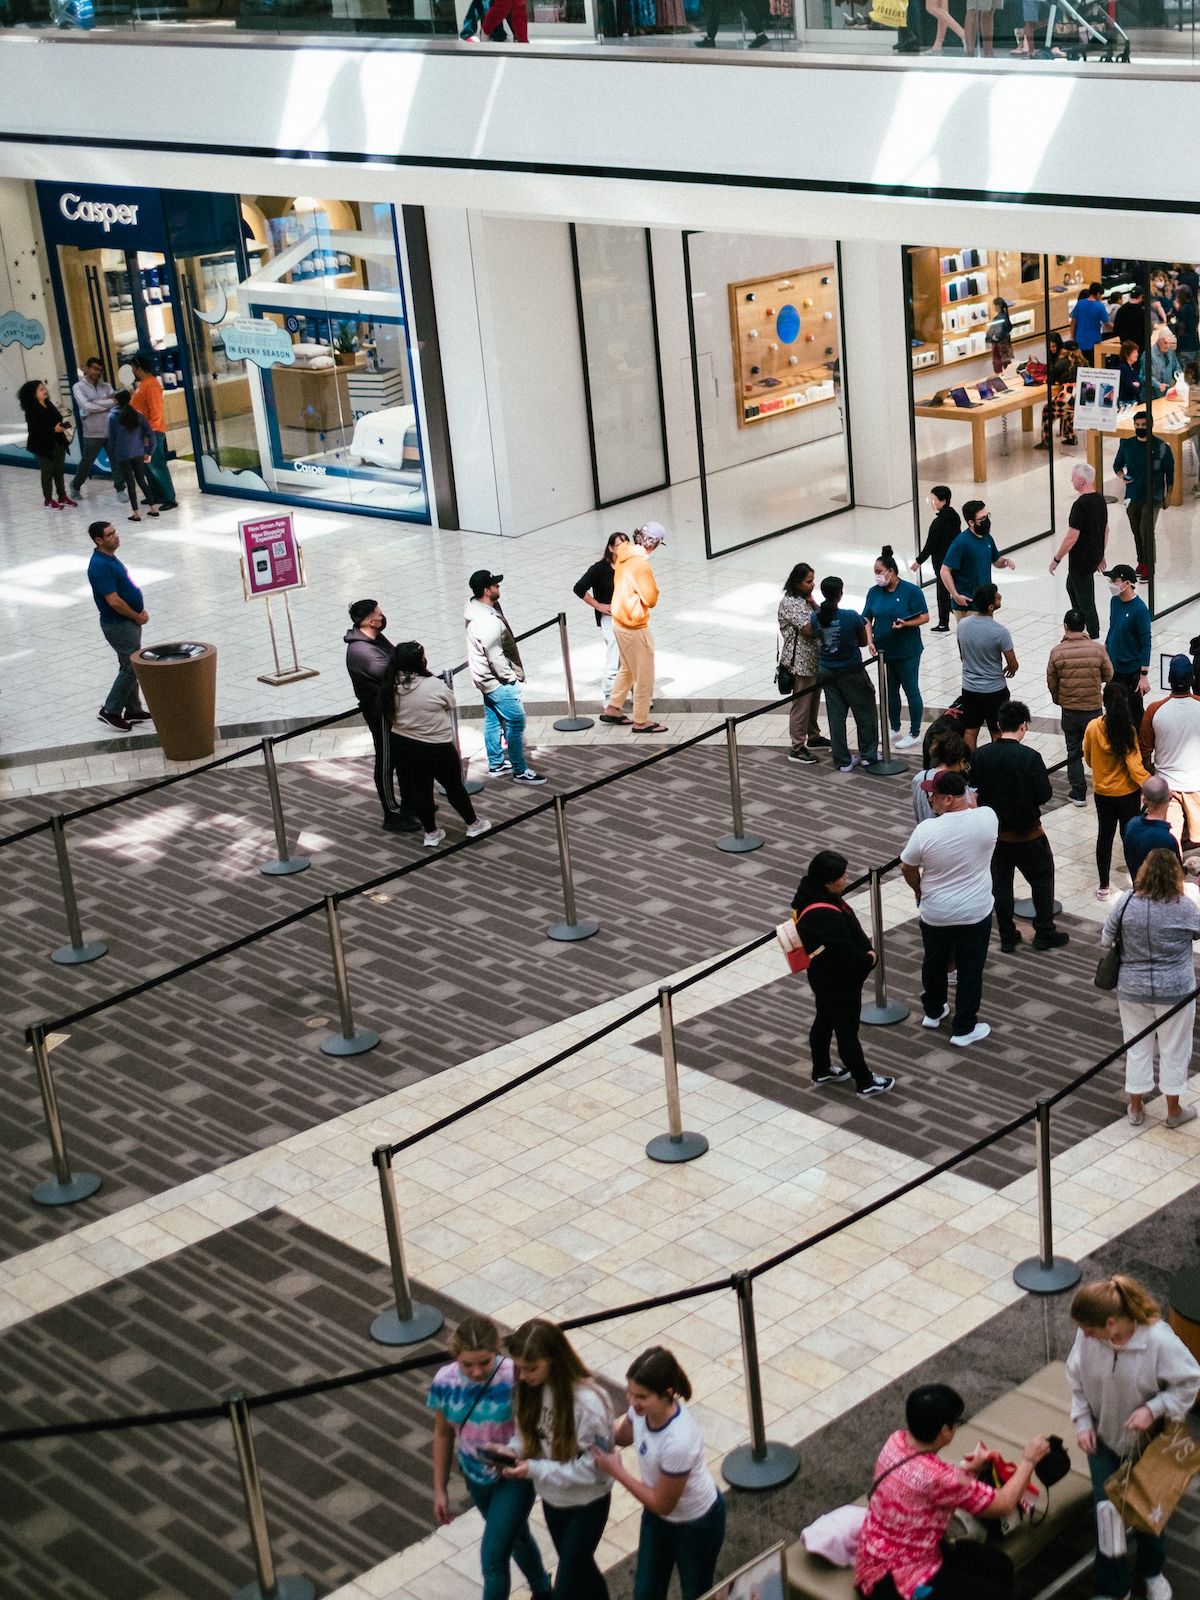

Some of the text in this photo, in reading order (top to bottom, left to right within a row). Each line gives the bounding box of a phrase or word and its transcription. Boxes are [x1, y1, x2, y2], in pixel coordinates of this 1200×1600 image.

[60, 192, 138, 232] Casper
[238, 347, 260, 355] EVERY
[262, 349, 290, 358] SEASON
[294, 461, 326, 477] Casper
